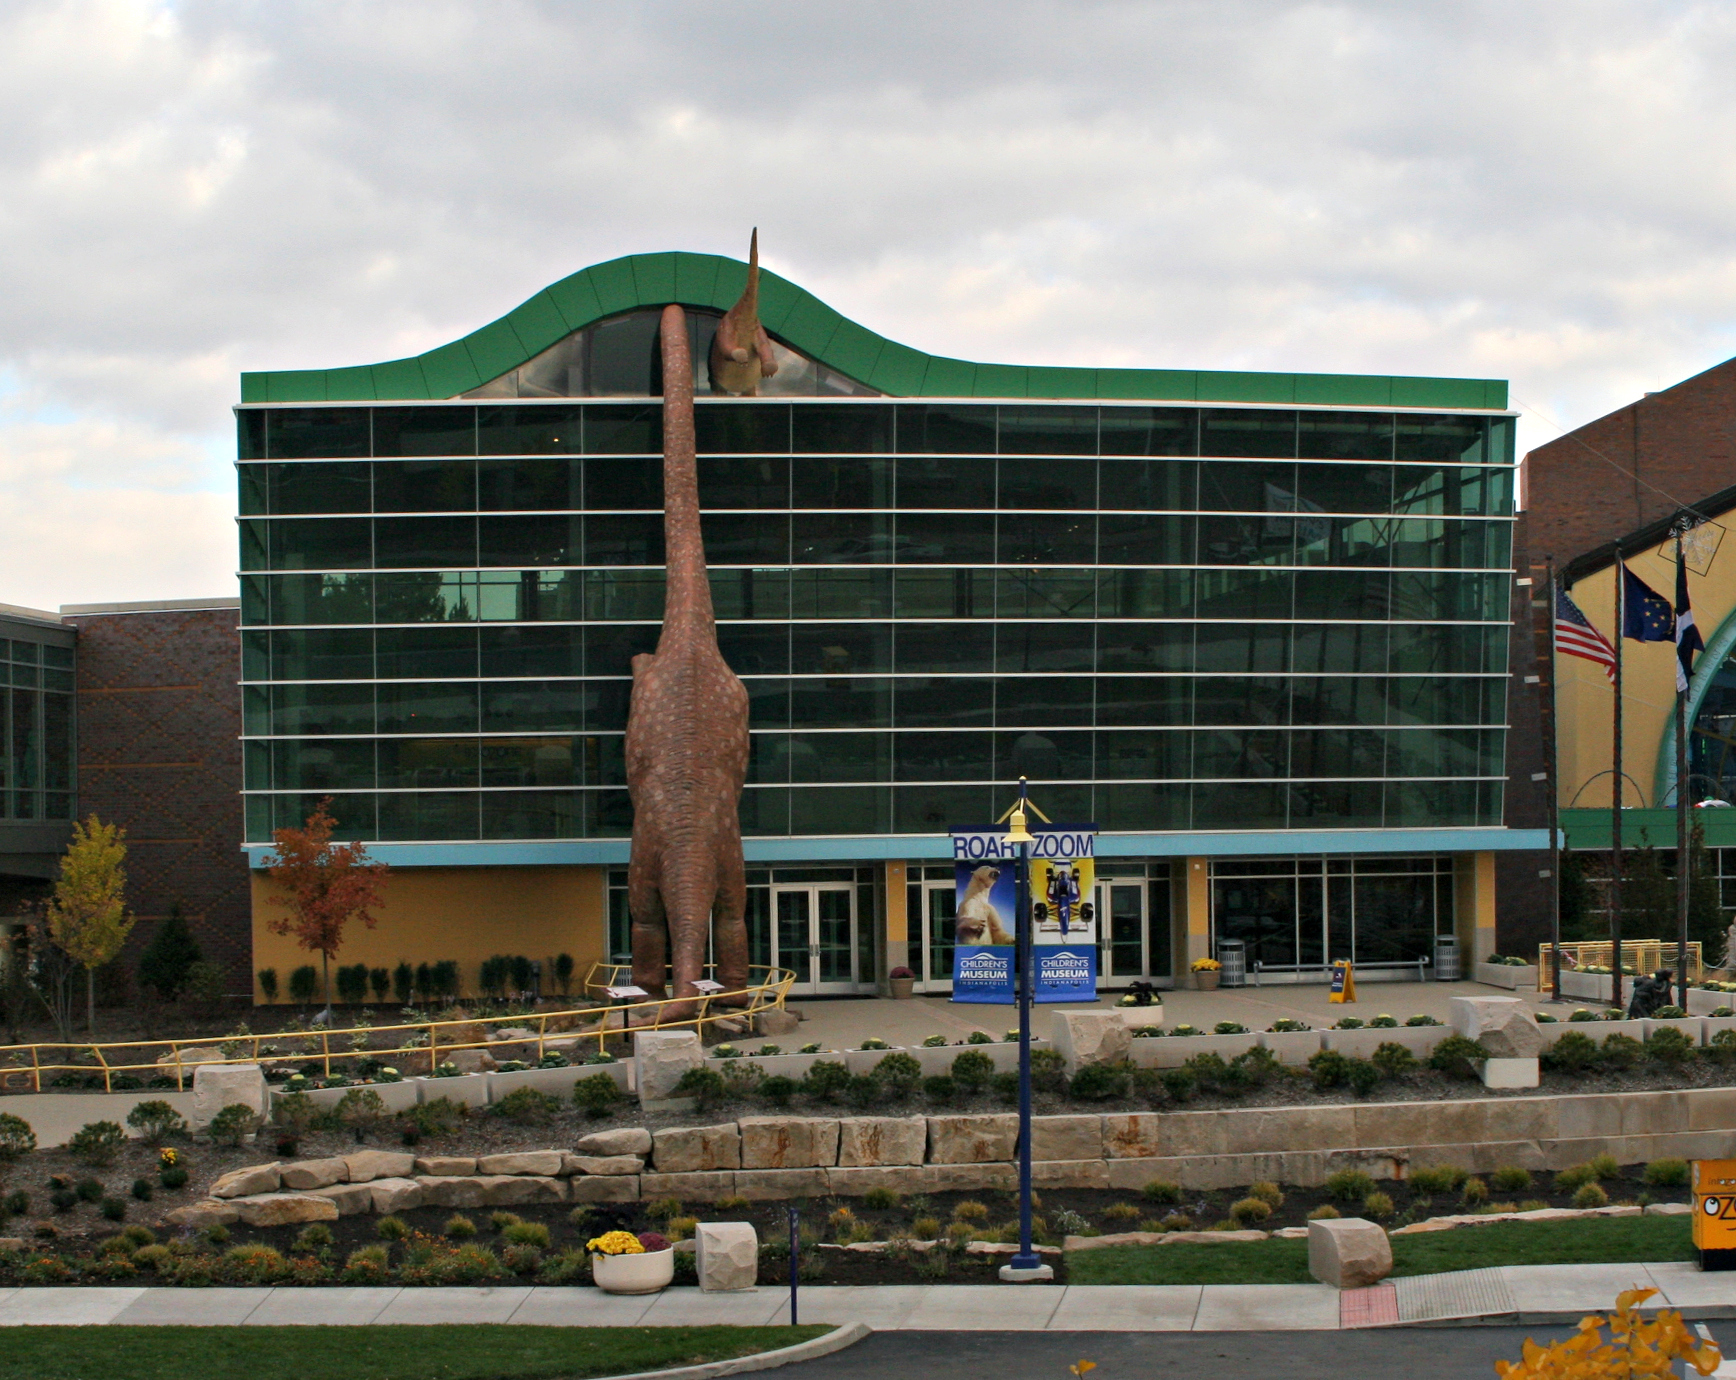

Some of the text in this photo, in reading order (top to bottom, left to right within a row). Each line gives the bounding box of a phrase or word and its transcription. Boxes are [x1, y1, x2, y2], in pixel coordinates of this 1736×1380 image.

[955, 836, 1014, 858] ROAR
[1032, 834, 1094, 858] ZOOM
[1040, 959, 1089, 968] CHILDREN'S
[959, 971, 1008, 979] MUSEUM
[1041, 970, 1088, 978] MUSEUM
